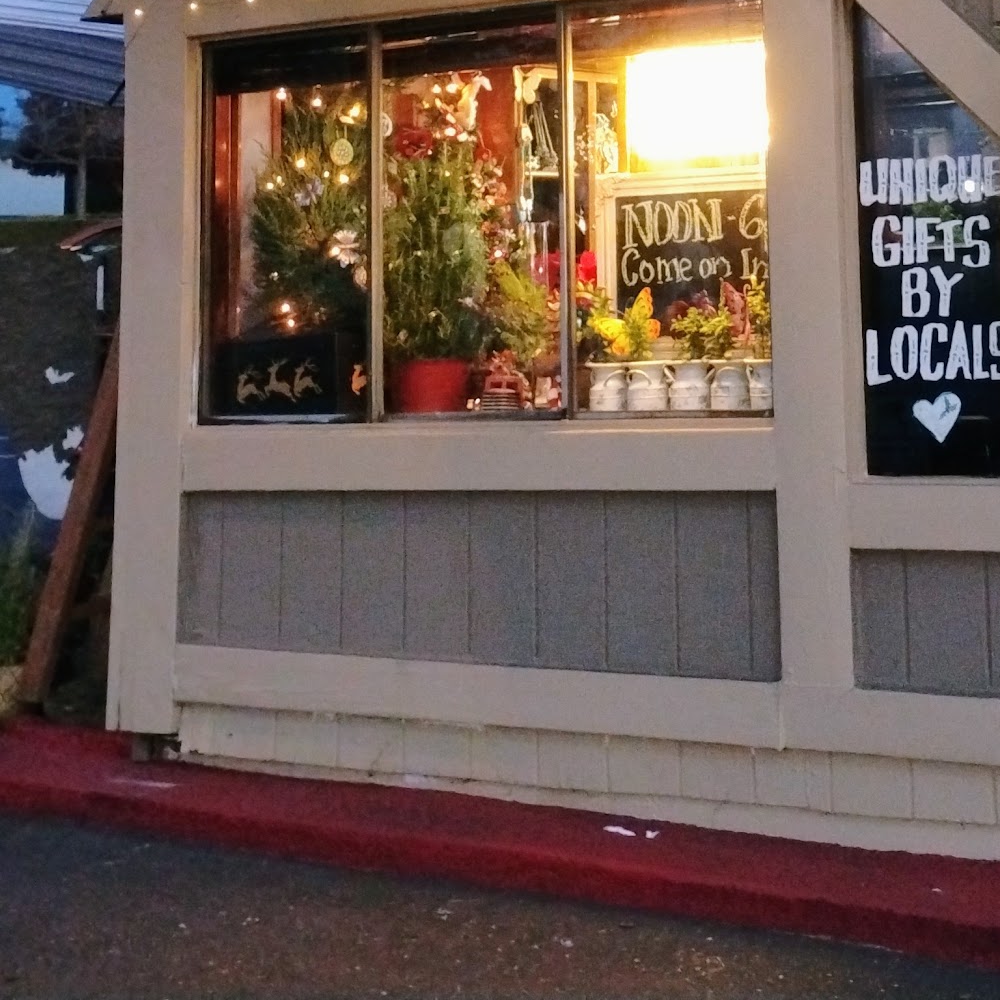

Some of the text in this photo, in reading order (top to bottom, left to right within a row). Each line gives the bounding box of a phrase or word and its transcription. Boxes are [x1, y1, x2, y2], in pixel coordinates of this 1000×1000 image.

[621, 248, 693, 287] Come
[699, 255, 733, 279] on
[871, 214, 991, 268] GIFTS
[901, 265, 964, 318] BY
